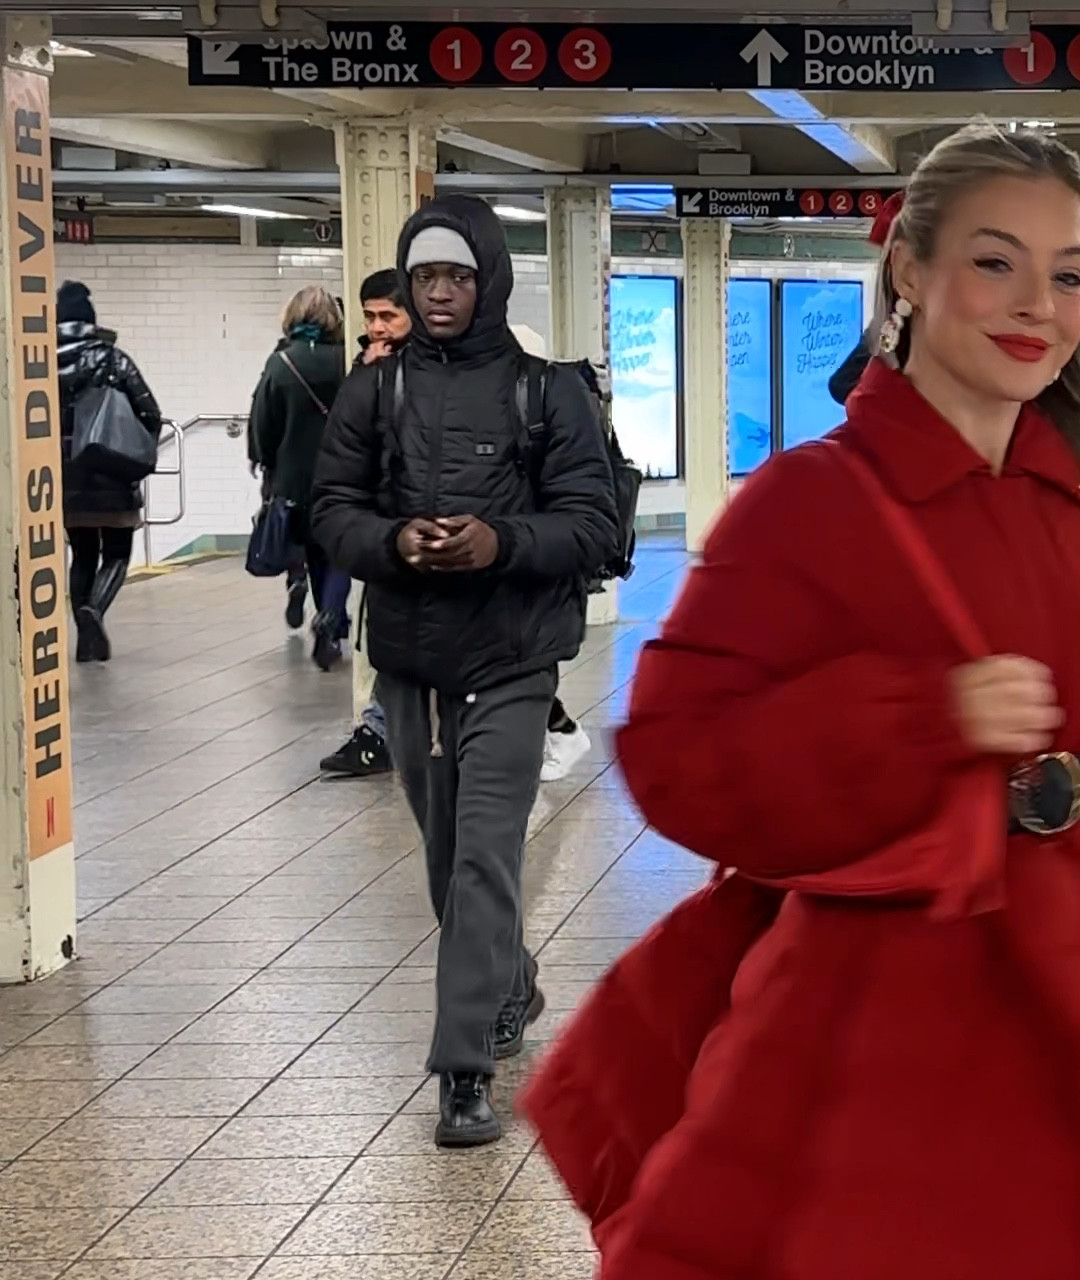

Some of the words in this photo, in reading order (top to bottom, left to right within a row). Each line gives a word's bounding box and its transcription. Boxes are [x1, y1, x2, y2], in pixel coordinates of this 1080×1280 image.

[386, 24, 407, 51] &
[446, 39, 462, 70] 1
[510, 39, 533, 70] 2
[573, 38, 597, 70] 3
[1020, 41, 1036, 73] 1
[262, 56, 319, 82] The
[331, 56, 420, 83] Bronx
[804, 59, 935, 90] Brooklyn
[708, 188, 781, 202] Downtown
[785, 188, 795, 202] &
[708, 202, 769, 217] Brooklyn
[806, 195, 816, 210] 1
[835, 195, 847, 210] 2
[864, 194, 877, 210] 3
[15, 105, 52, 441] DELIVER
[27, 464, 63, 780] HEROES
